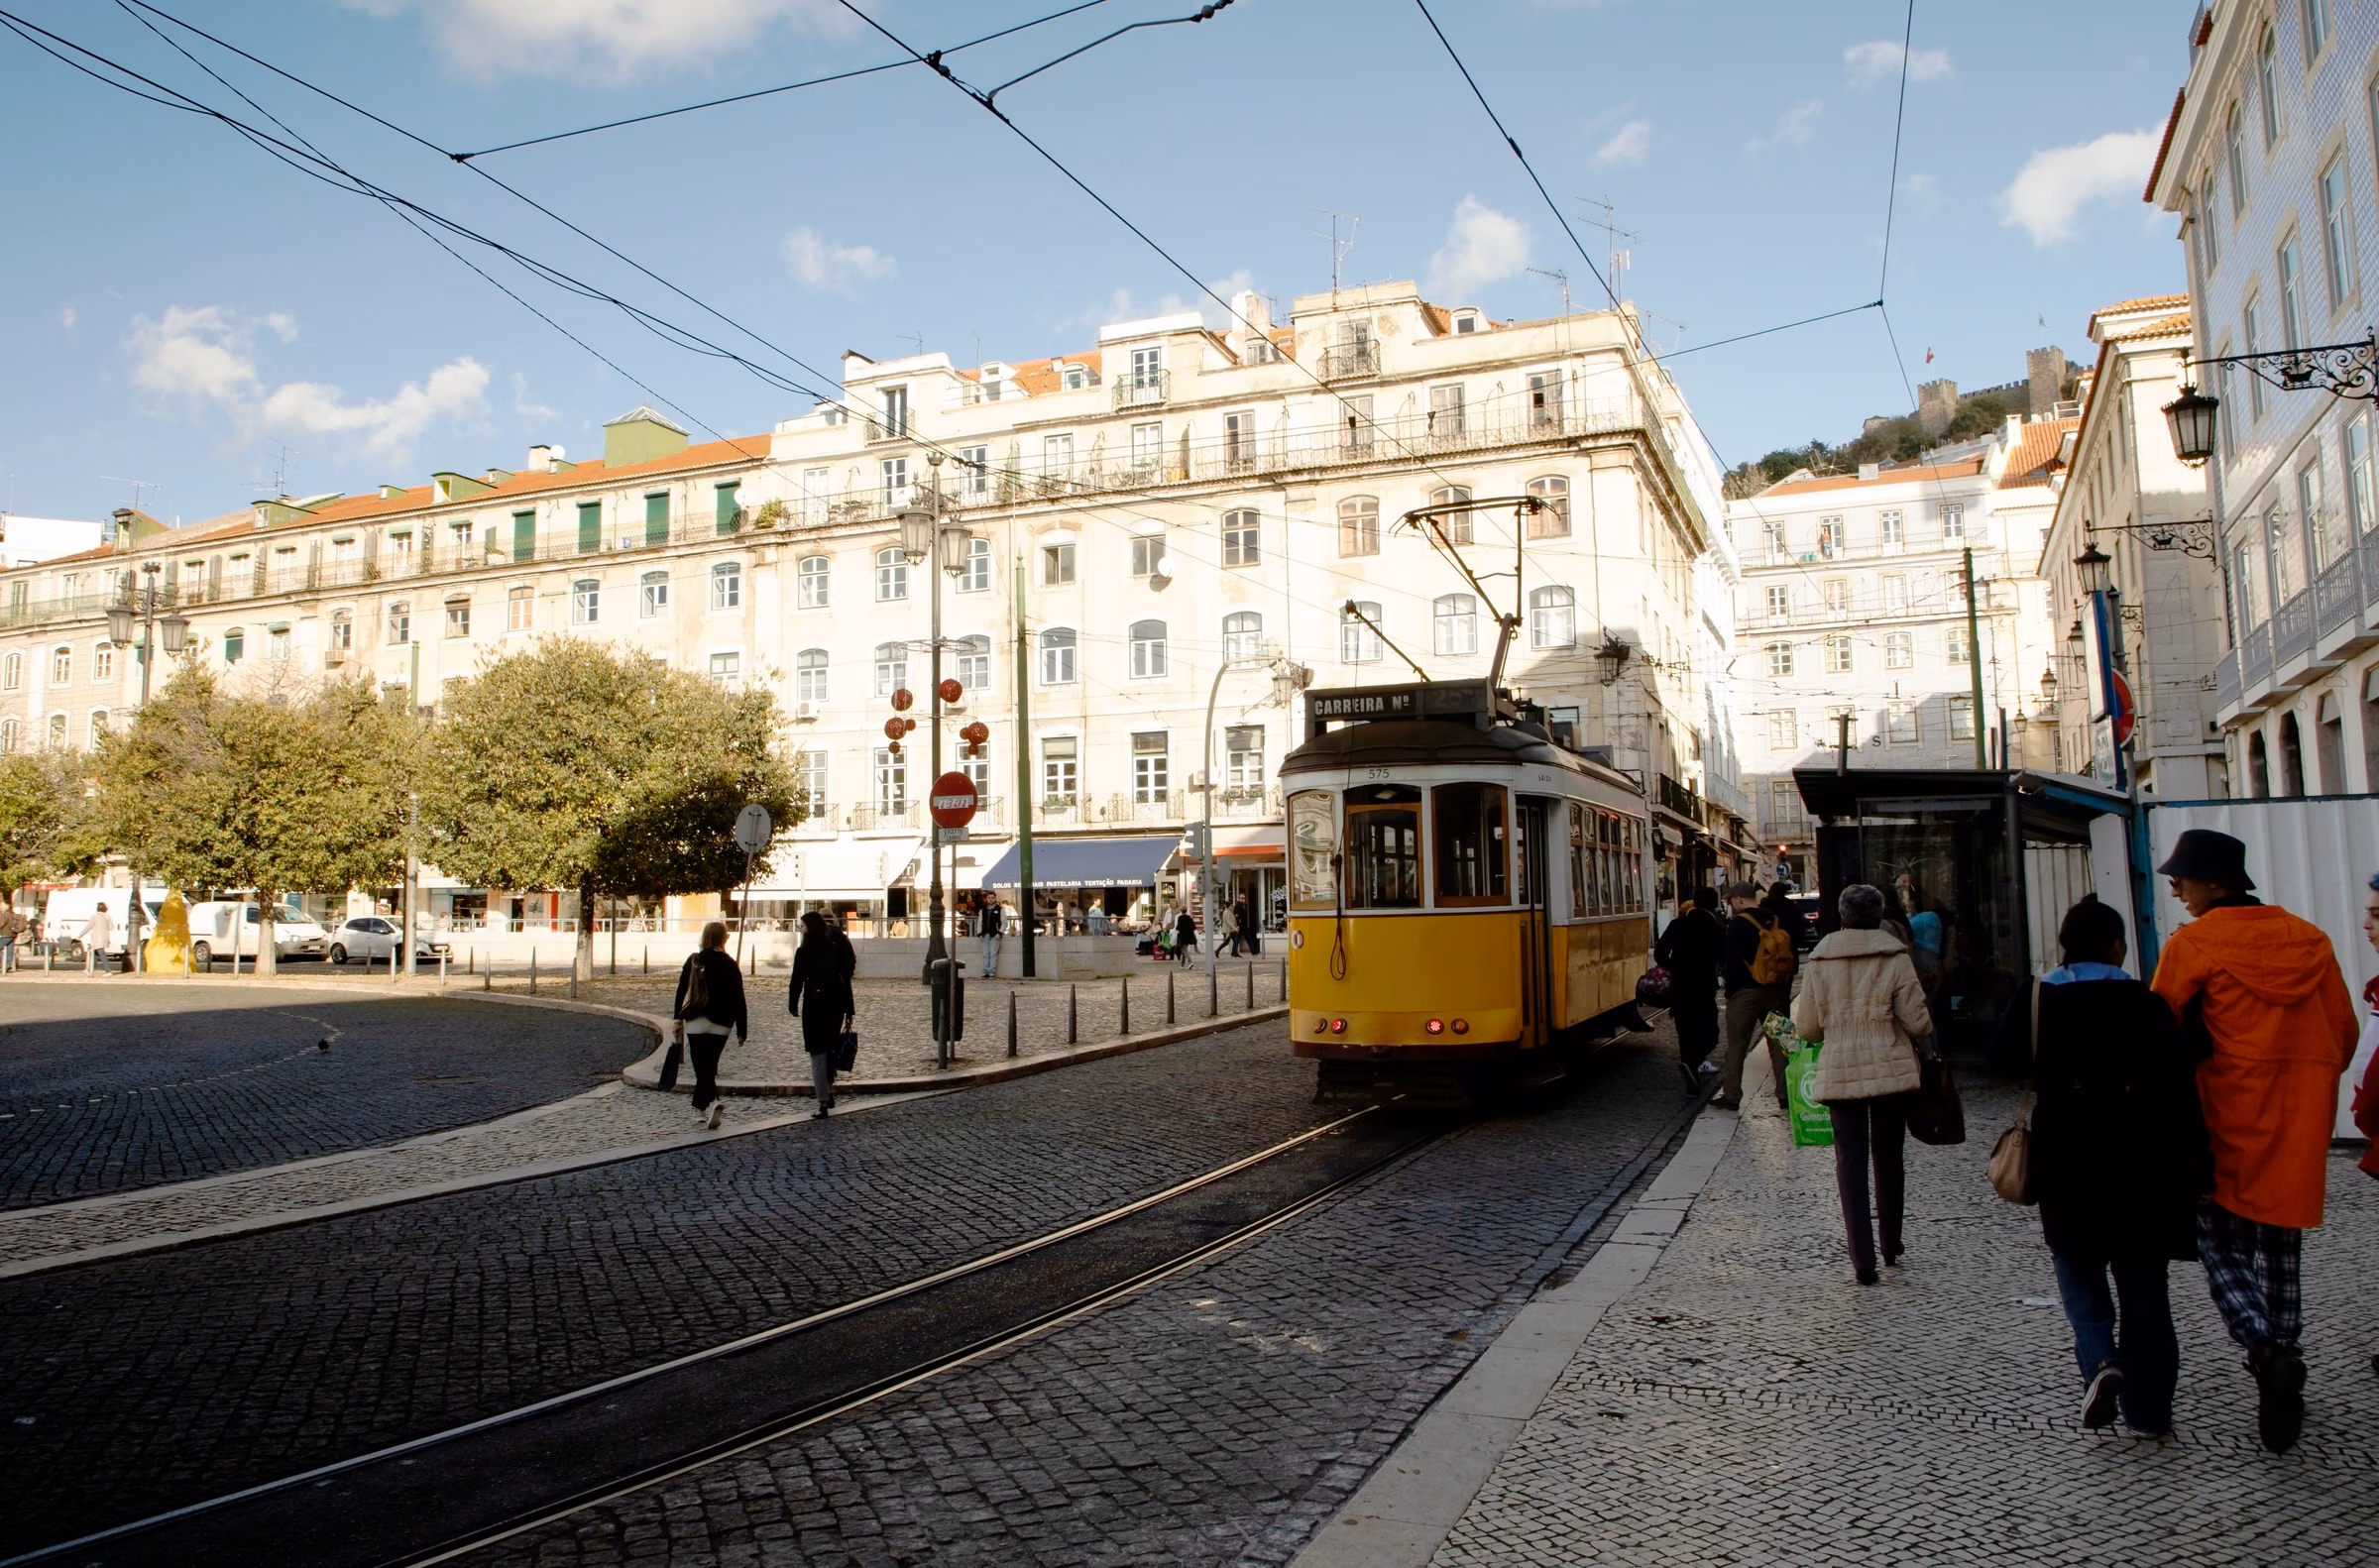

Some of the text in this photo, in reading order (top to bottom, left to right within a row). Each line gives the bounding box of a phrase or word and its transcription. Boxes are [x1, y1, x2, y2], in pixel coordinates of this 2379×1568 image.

[1314, 695, 1410, 715] CARREIRA Nº
[1369, 768, 1390, 780] 575
[1084, 878, 1114, 888] TENTAÇÃO
